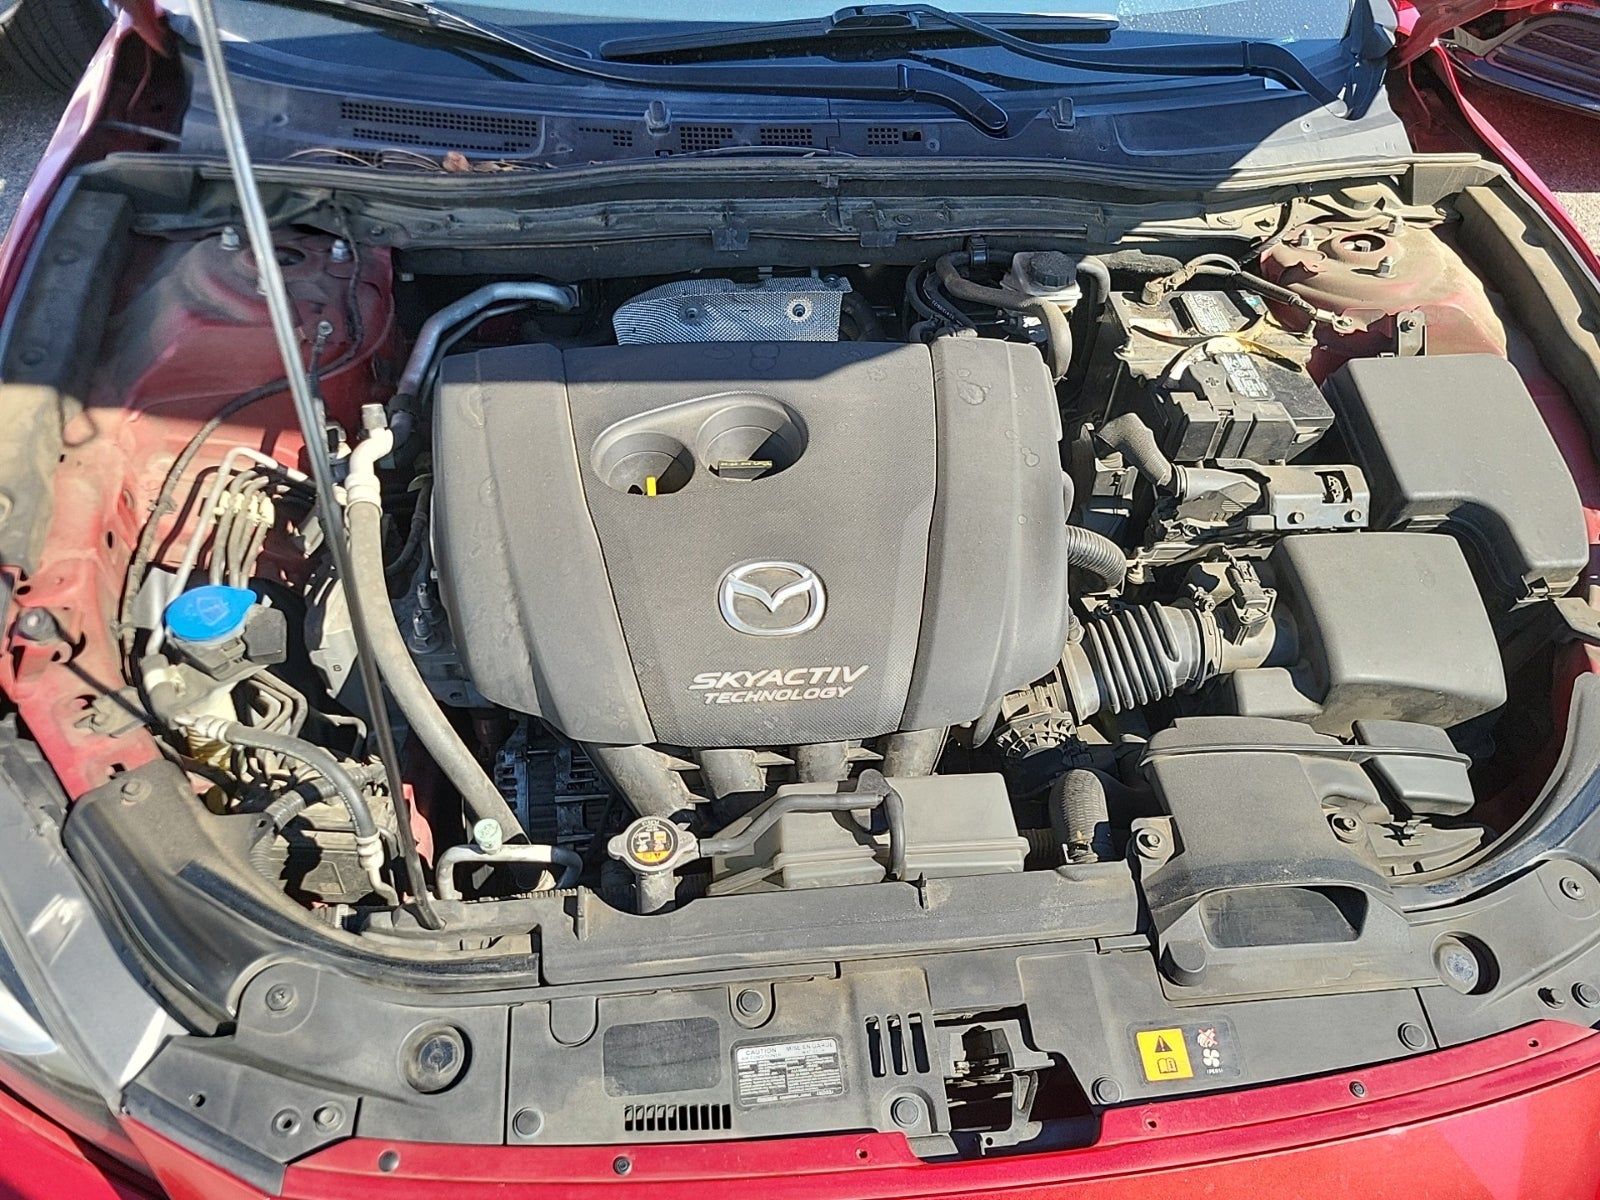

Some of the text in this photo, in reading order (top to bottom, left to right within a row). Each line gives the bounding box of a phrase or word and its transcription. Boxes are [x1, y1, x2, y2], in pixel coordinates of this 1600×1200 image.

[688, 665, 869, 690] SKYACTIV
[704, 686, 853, 704] TECHNOLOGY
[745, 1047, 777, 1056] CAUTION
